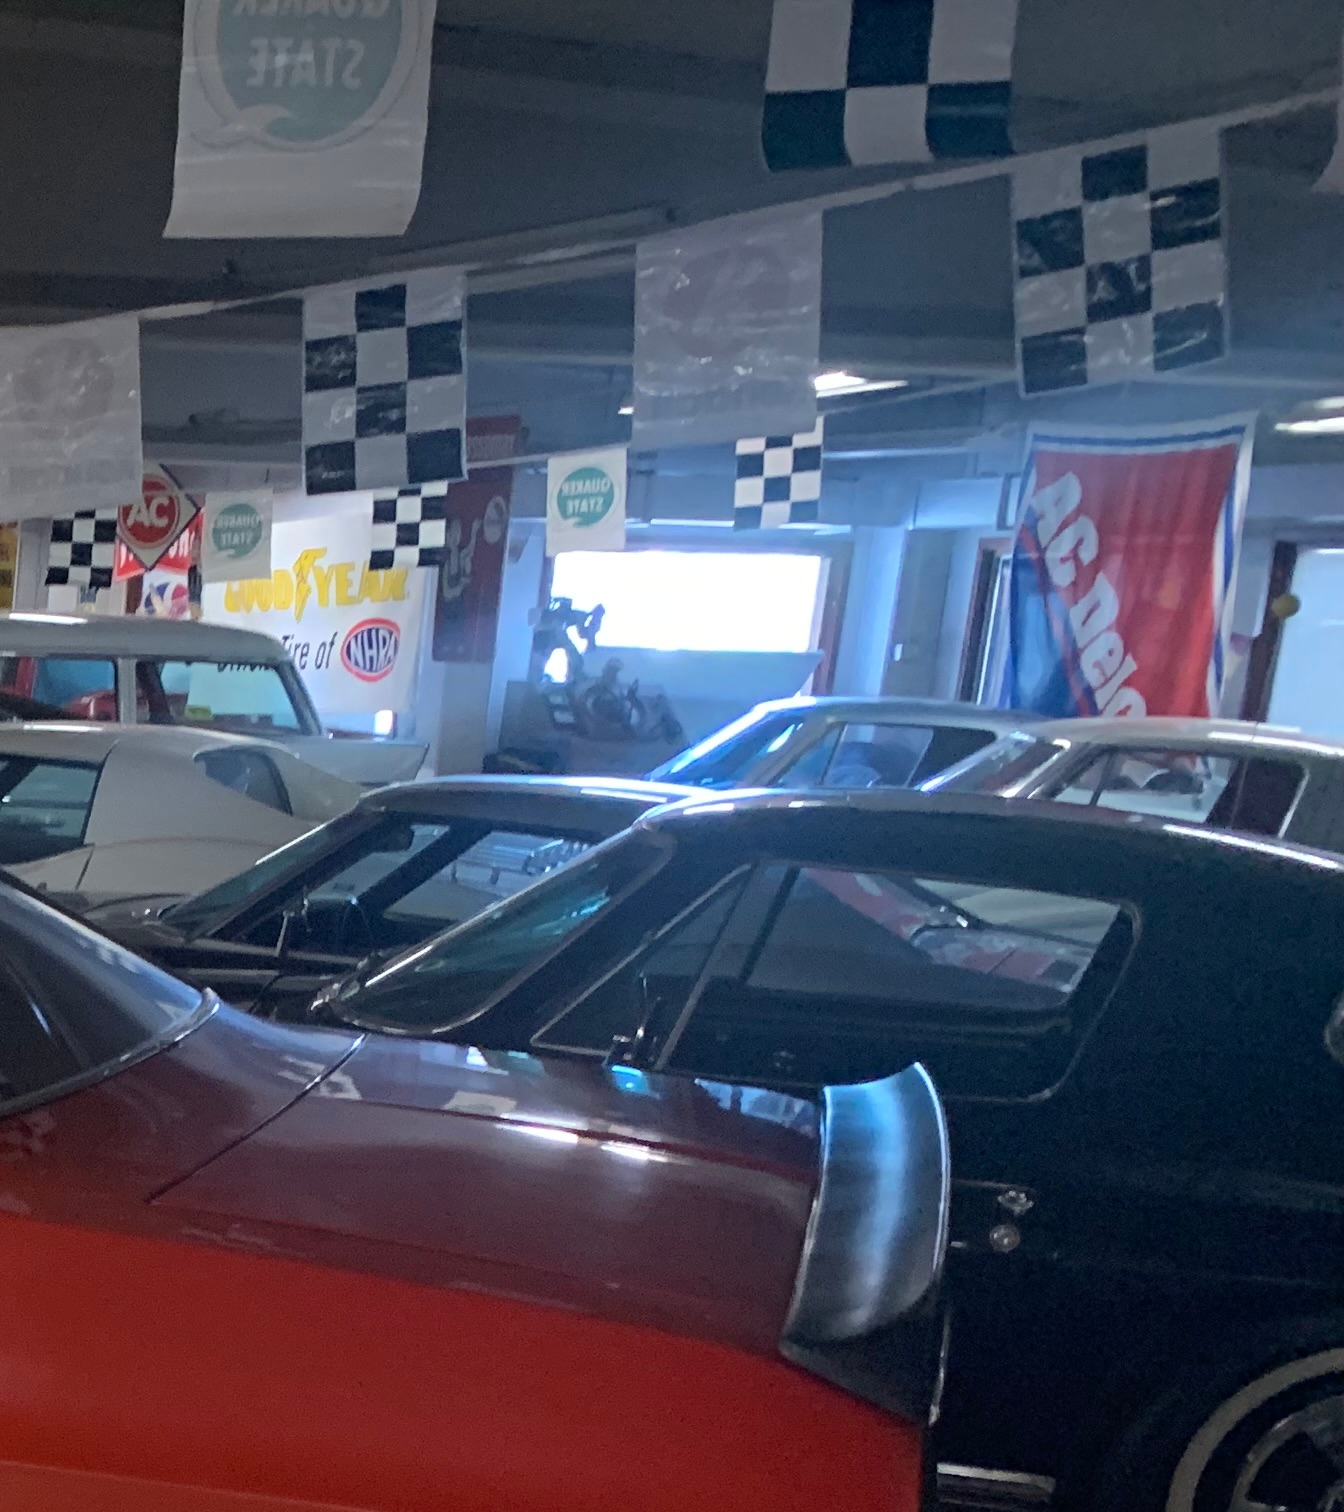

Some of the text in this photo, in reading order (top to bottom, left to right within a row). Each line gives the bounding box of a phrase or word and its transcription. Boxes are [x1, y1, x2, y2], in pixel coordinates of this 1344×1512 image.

[126, 496, 170, 529] AC
[1032, 471, 1099, 588] AC
[314, 631, 339, 670] of
[345, 626, 400, 674] NHRA
